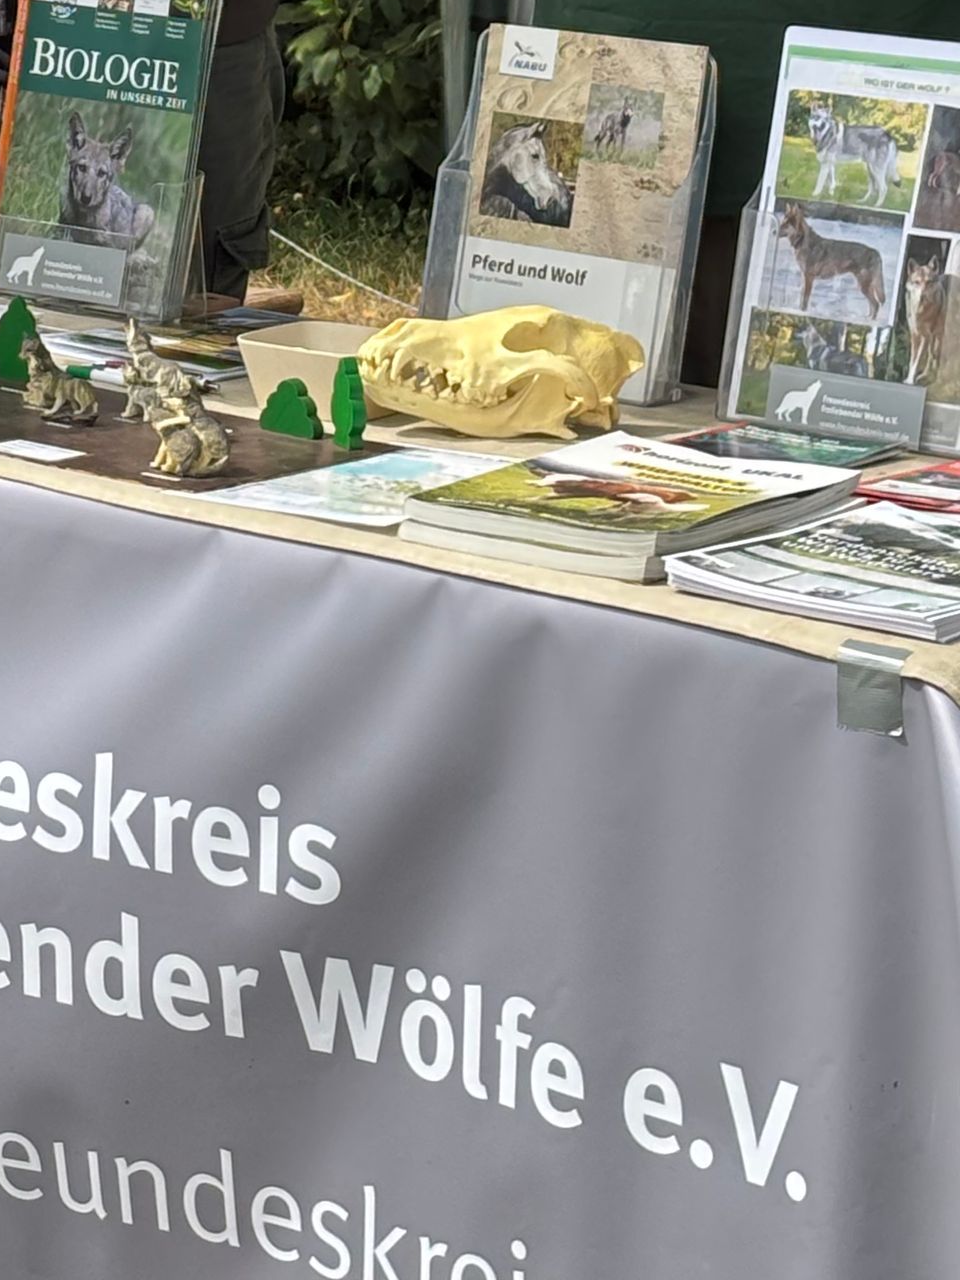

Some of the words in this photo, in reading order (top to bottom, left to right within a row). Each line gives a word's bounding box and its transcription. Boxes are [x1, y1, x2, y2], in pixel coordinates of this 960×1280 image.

[29, 37, 179, 94] BIOLOGIE
[514, 59, 547, 72] NABU
[106, 89, 118, 100] IN
[120, 91, 163, 106] UNSERER
[165, 96, 187, 110] ZEIT
[471, 254, 514, 274] Pferd
[517, 264, 548, 280] und
[551, 266, 588, 286] Wolf
[280, 950, 585, 1128] Wölfe
[623, 1063, 807, 1201] e.V.
